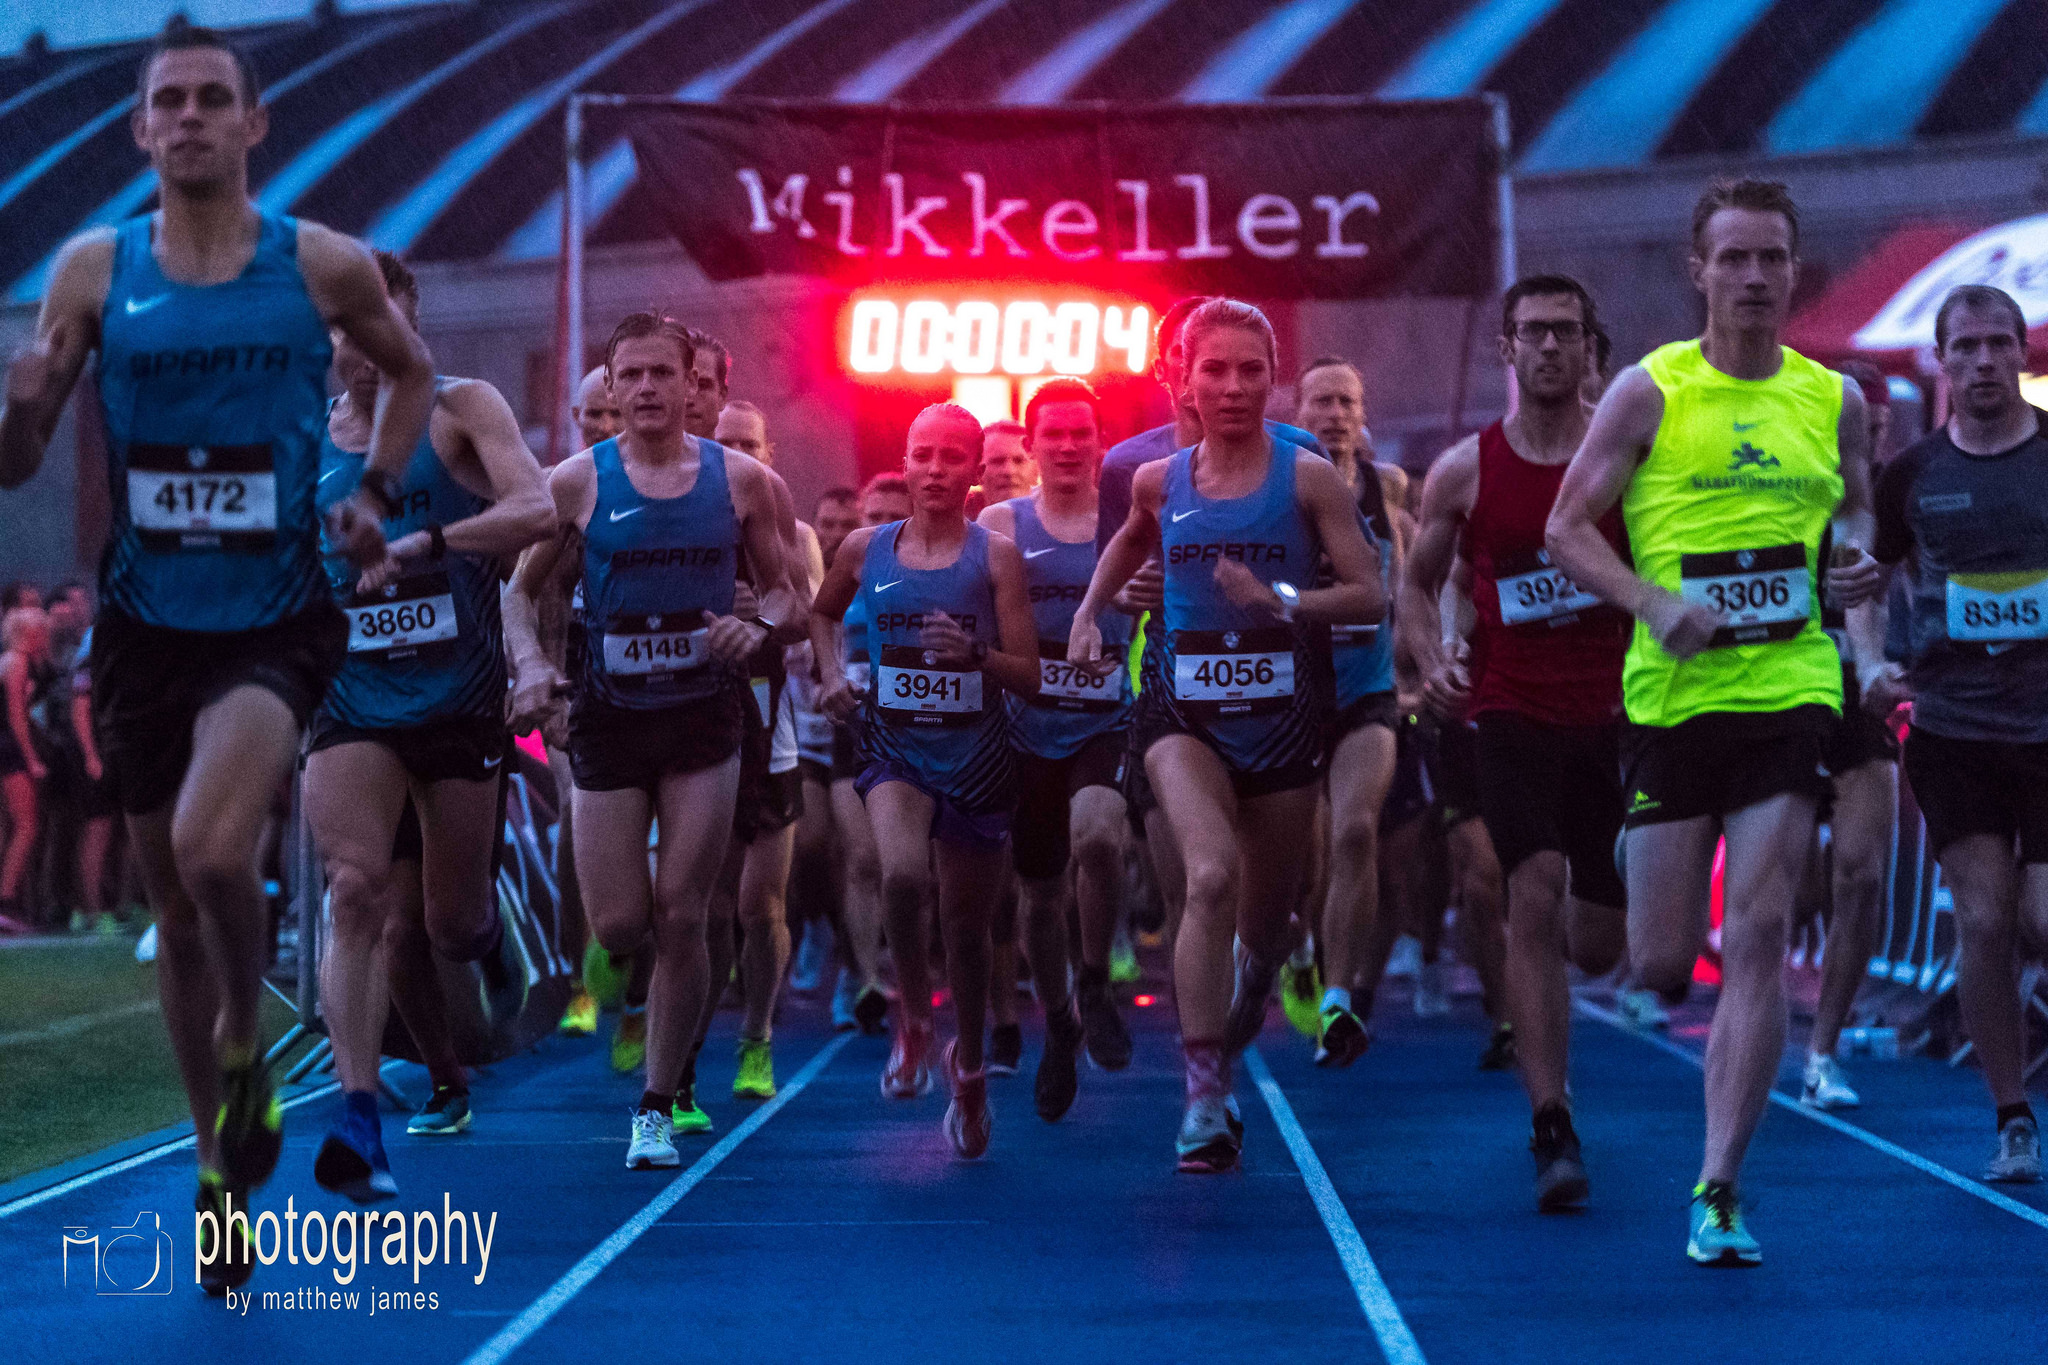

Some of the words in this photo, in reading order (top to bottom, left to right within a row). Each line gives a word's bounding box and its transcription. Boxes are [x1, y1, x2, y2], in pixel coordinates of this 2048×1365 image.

[736, 165, 1381, 262] Mikkeller
[848, 300, 1150, 374] 00:00:04
[154, 478, 247, 513] 4172
[612, 547, 722, 569] SPARTA
[1169, 543, 1286, 564] SPARTA
[1706, 575, 1790, 614] 3306
[358, 602, 436, 637] 3860
[877, 613, 977, 632] SPAA
[1964, 599, 2040, 627] 8345
[624, 637, 691, 662] 4148
[1194, 658, 1274, 687] 4056
[894, 673, 961, 701] 3941
